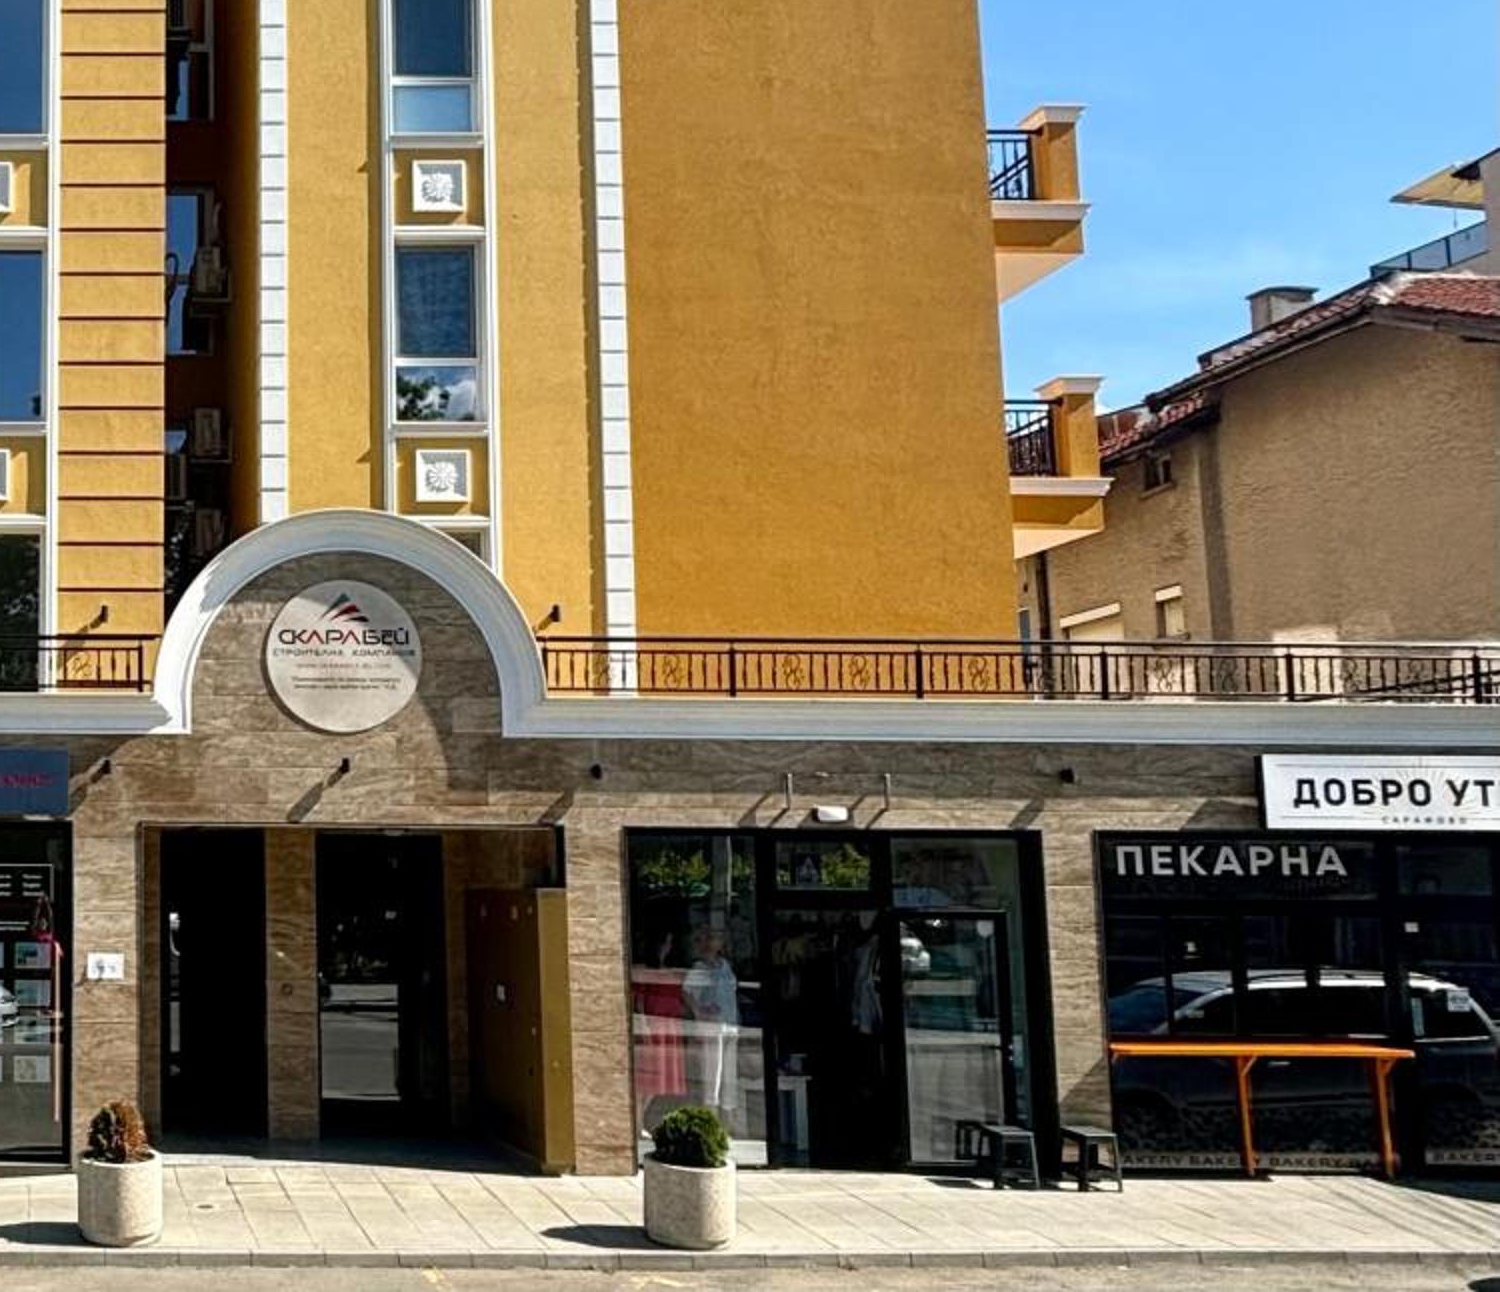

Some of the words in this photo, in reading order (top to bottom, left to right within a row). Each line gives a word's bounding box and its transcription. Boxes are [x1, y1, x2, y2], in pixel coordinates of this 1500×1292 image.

[1292, 777, 1433, 809] ДОБРО
[1116, 844, 1349, 877] ПЕКАРНА
[1122, 1154, 1183, 1167] AKERY
[1189, 1154, 1262, 1168] BAKEY
[1432, 1151, 1500, 1164] BAKER
